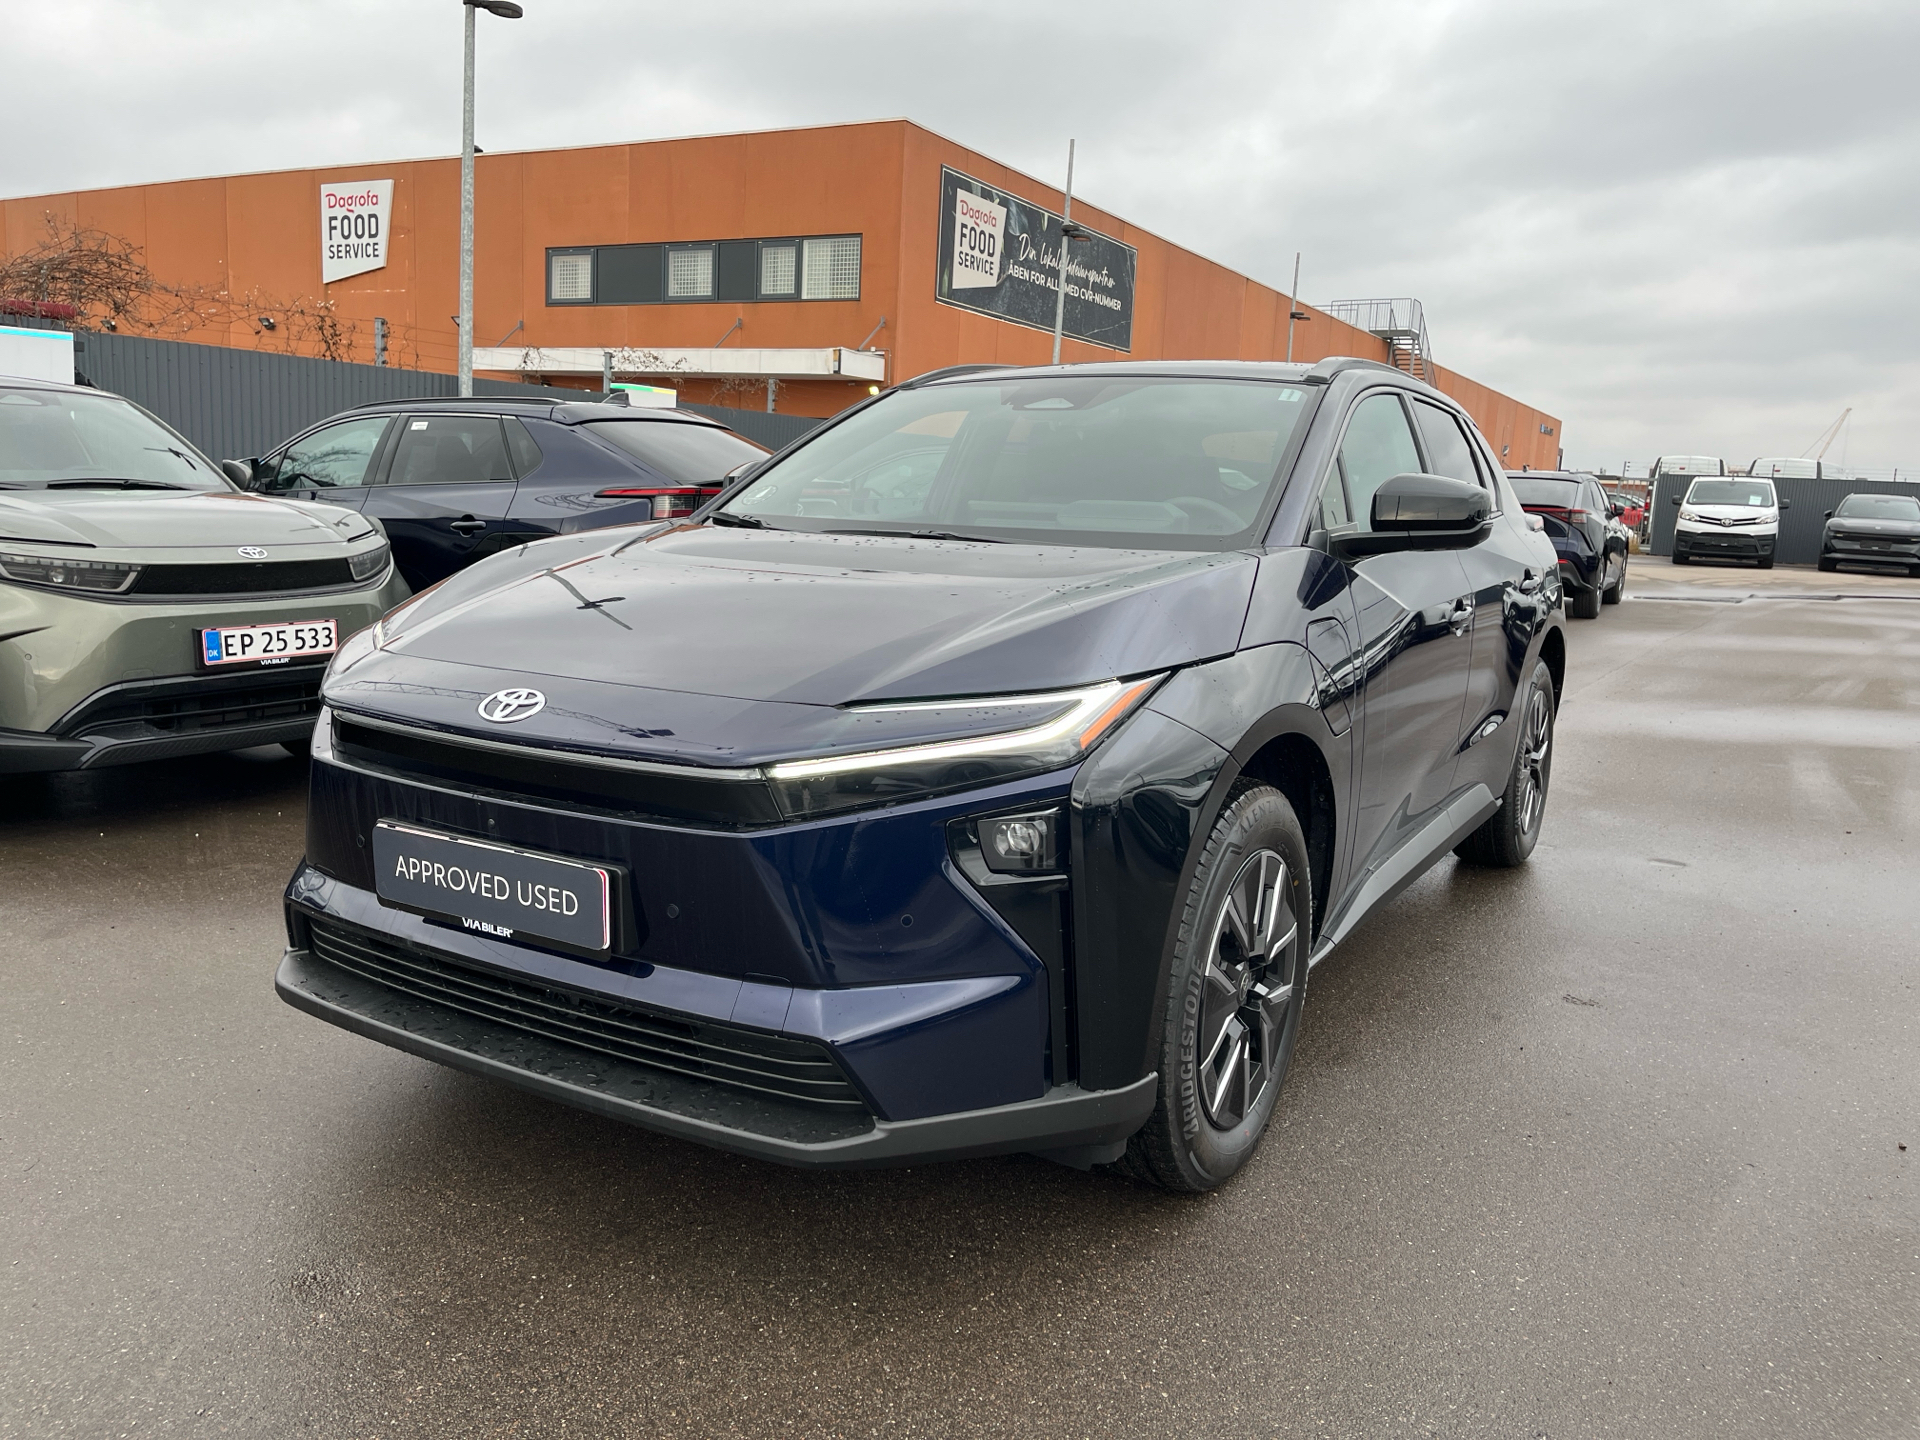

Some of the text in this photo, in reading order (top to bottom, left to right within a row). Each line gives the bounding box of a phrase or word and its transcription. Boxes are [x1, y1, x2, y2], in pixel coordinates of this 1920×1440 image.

[325, 190, 379, 213] Dagrofa
[959, 199, 997, 228] Dagrofa
[328, 213, 379, 241] FOOD
[959, 222, 997, 258] FOOD
[328, 242, 380, 260] SERVICE
[1018, 233, 1037, 261] Din
[958, 250, 995, 276] SERVICE
[1008, 259, 1122, 311] ÅBEN FOR ALL MED CVR-NUMMER
[208, 649, 219, 657] DK
[224, 626, 334, 657] EP 25 533
[395, 854, 579, 916] APPROVED USED
[1179, 958, 1204, 1141] BRIDGESTONE
